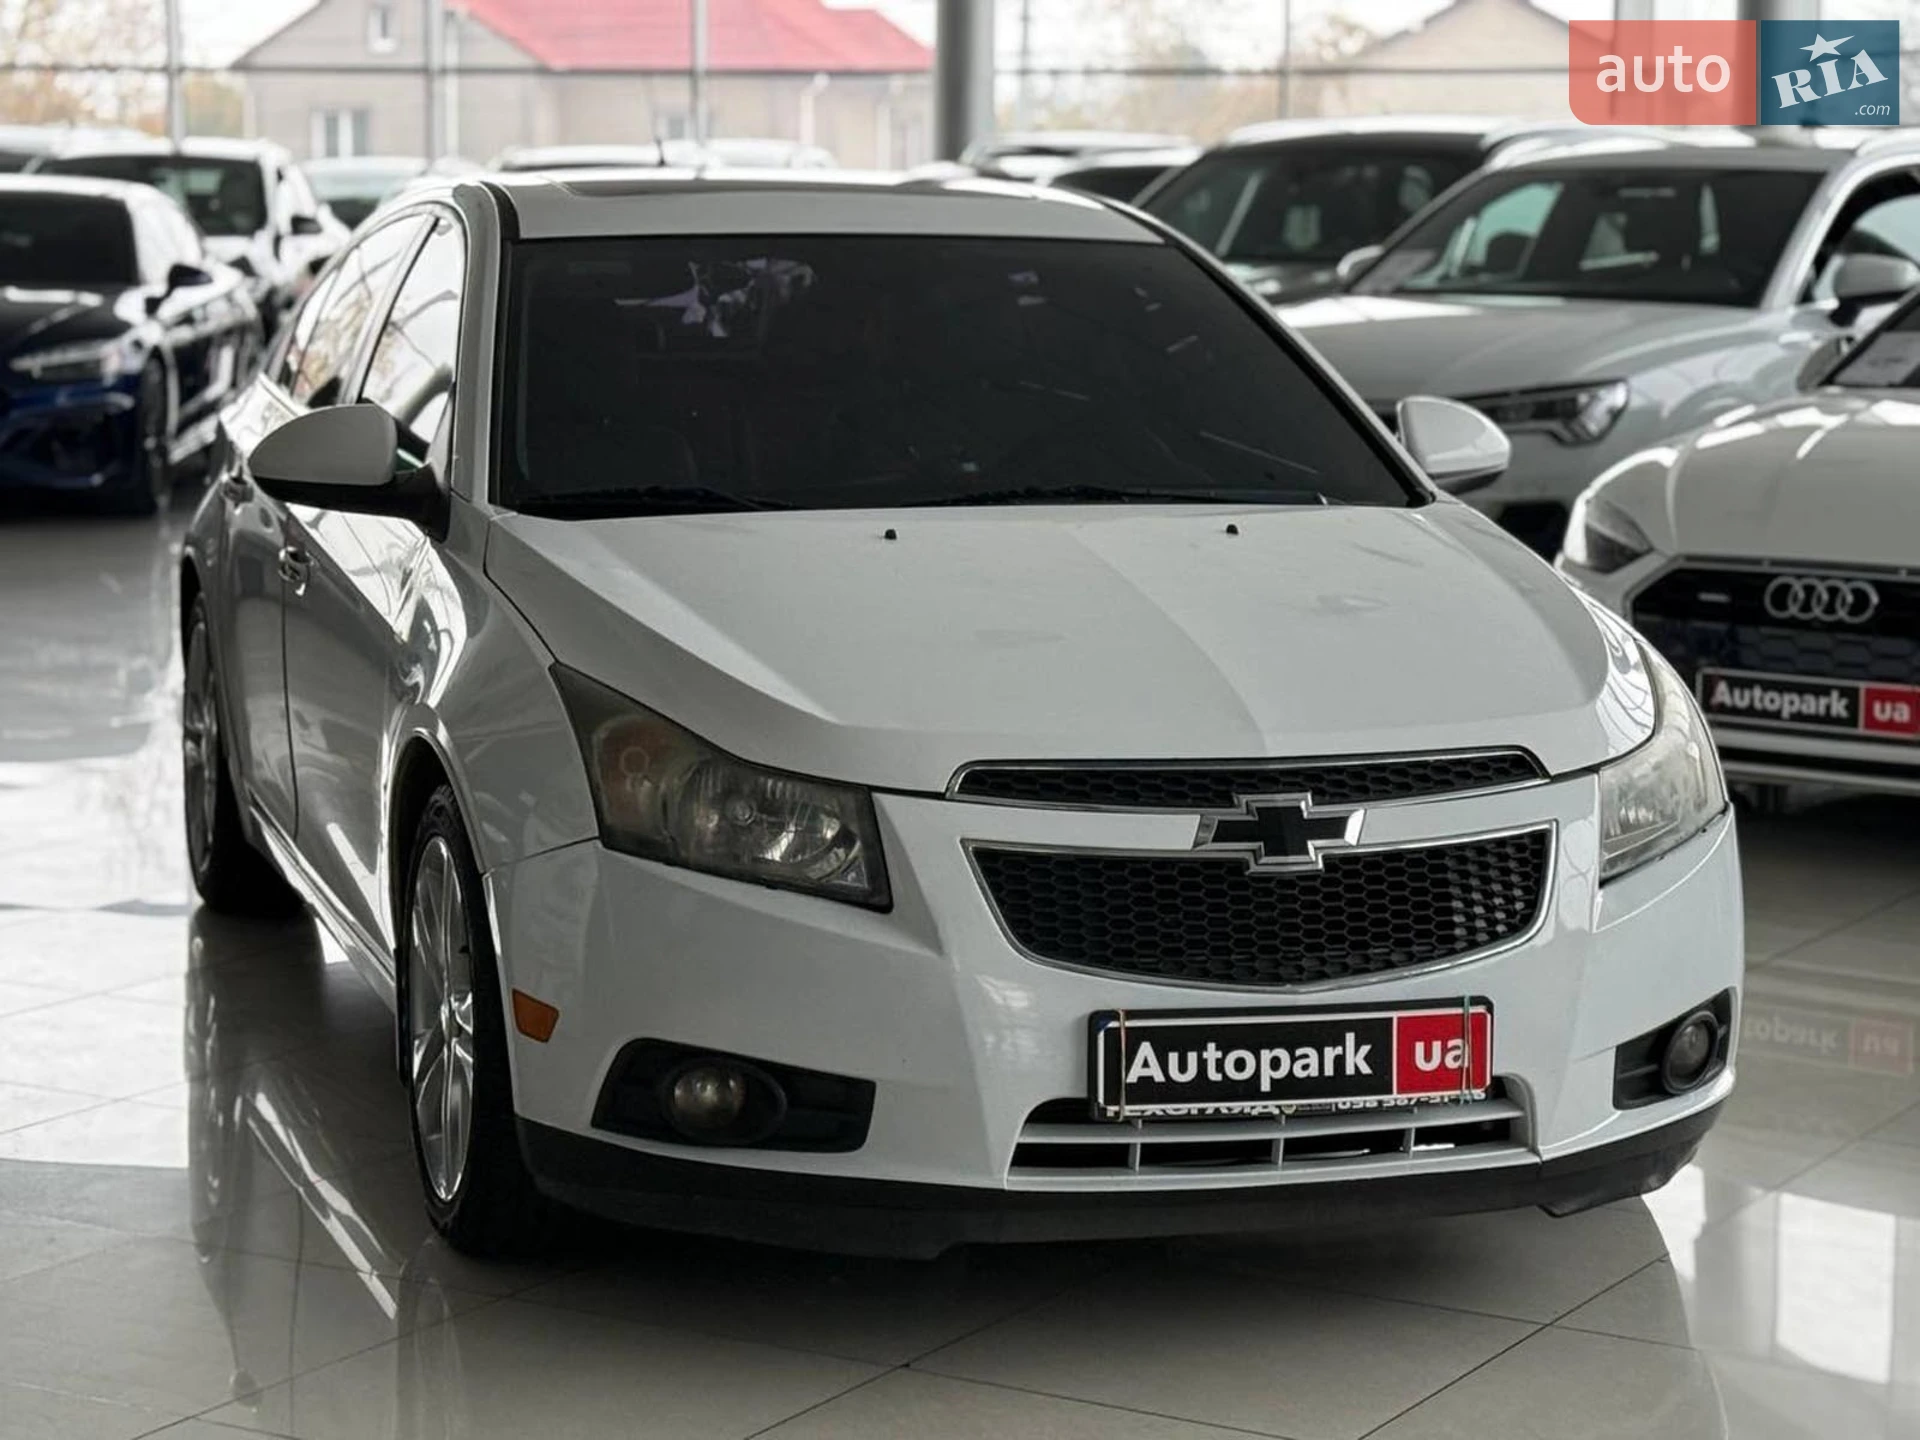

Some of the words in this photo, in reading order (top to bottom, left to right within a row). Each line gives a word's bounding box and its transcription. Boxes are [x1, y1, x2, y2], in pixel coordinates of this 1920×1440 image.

[1710, 679, 1849, 720] Autopark
[1872, 701, 1911, 723] ua
[1126, 1032, 1373, 1092] Autopark
[1414, 1038, 1470, 1072] ua
